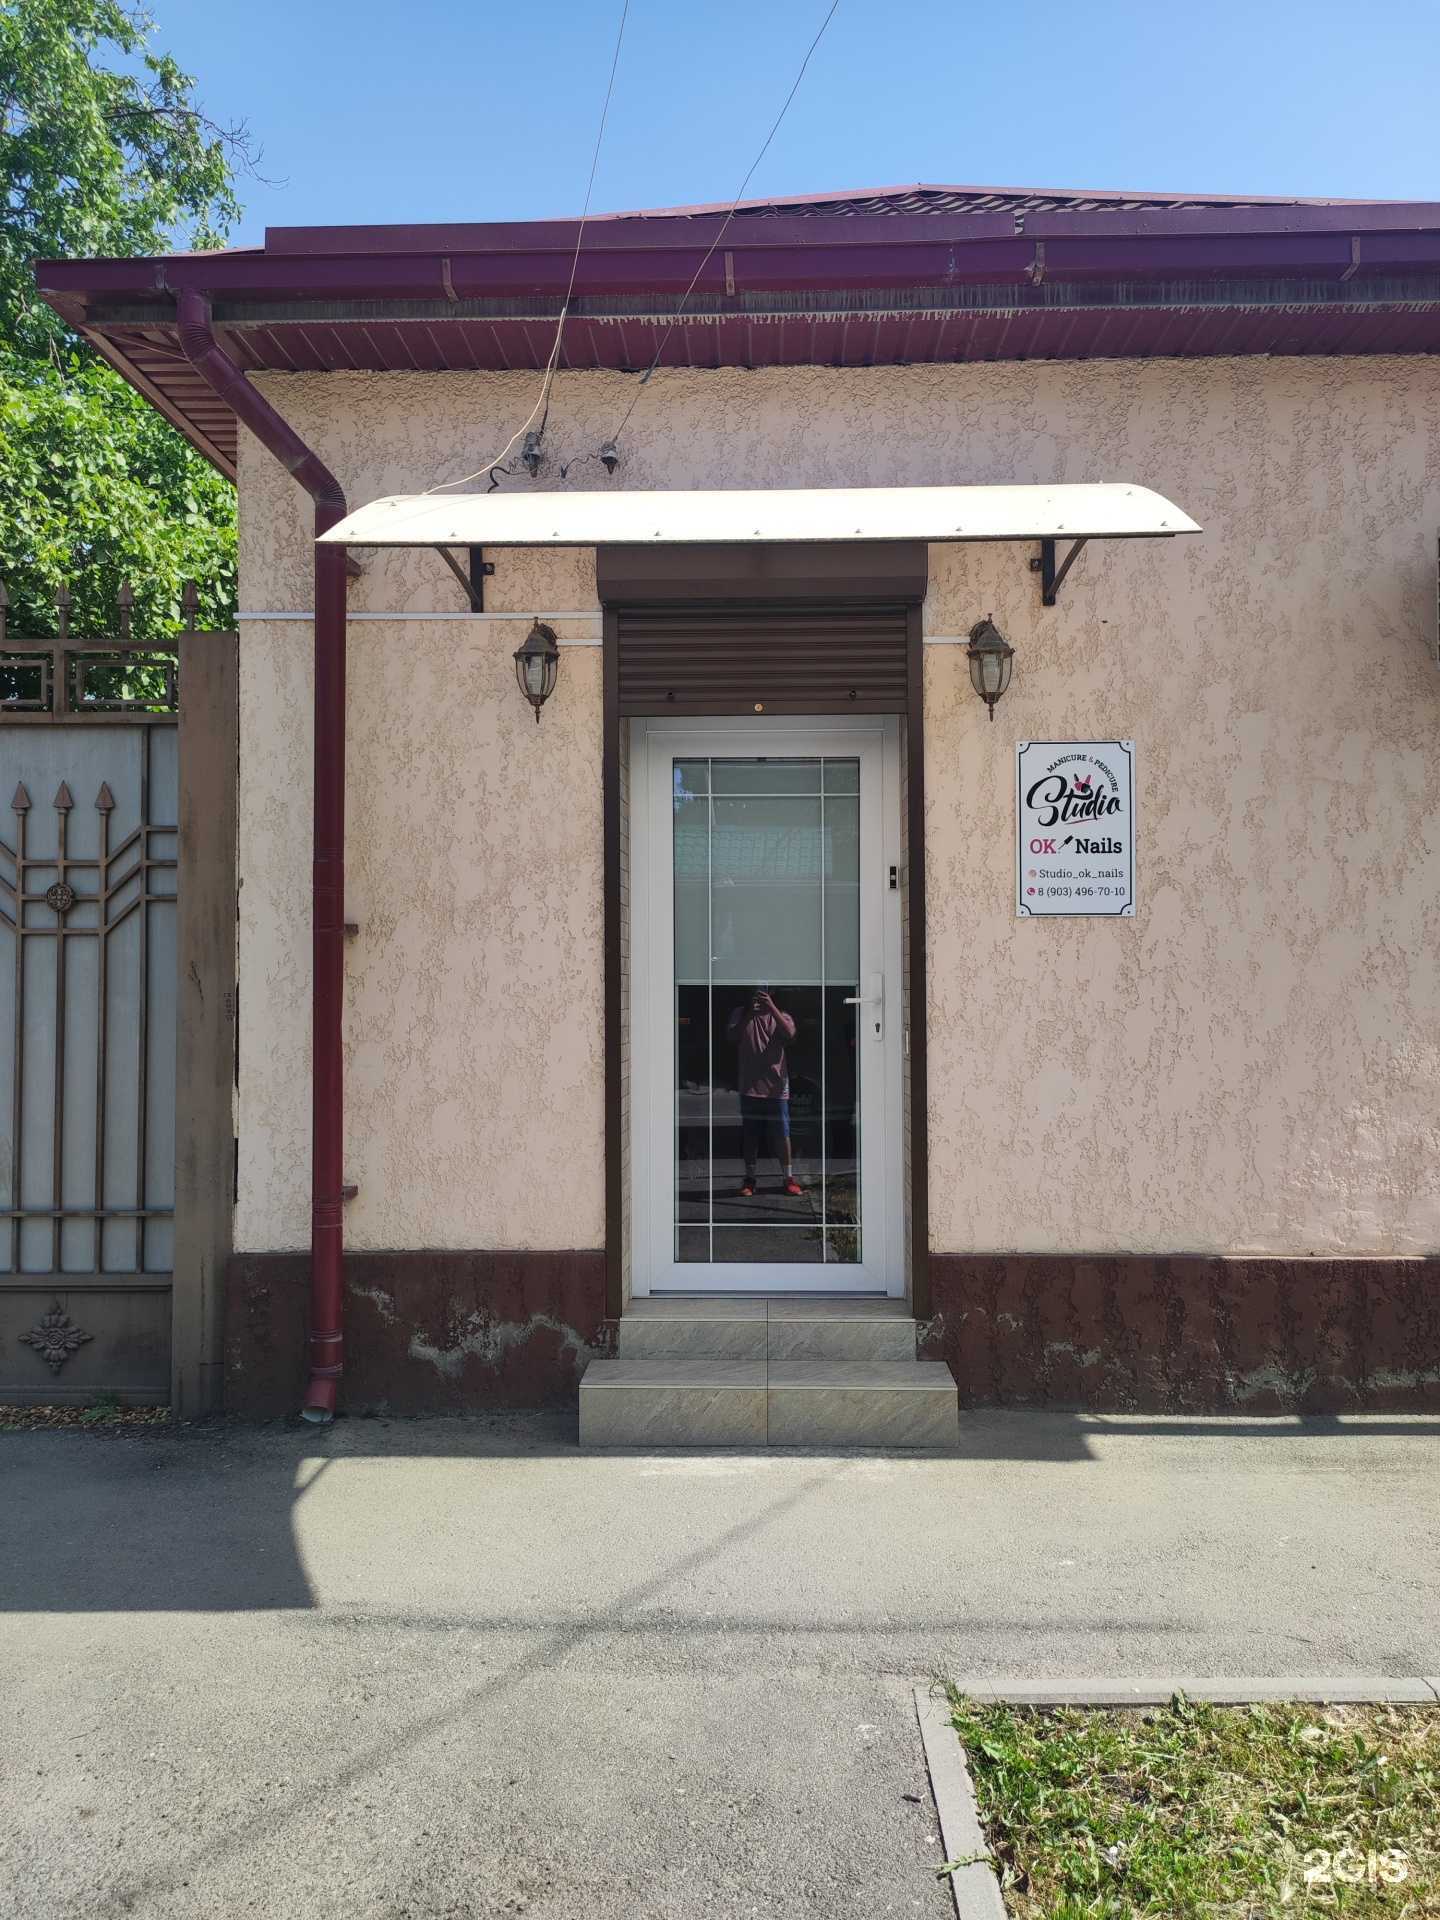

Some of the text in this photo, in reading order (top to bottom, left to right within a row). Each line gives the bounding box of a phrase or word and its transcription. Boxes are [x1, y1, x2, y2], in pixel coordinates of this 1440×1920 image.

[1046, 754, 1087, 773] MANICURE
[1094, 759, 1119, 792] PEDICURE
[1029, 838, 1122, 854] OK Nails
[1039, 868, 1124, 879] Studio_ok_nails
[1038, 886, 1126, 898] 8 (903) 496-70-10
